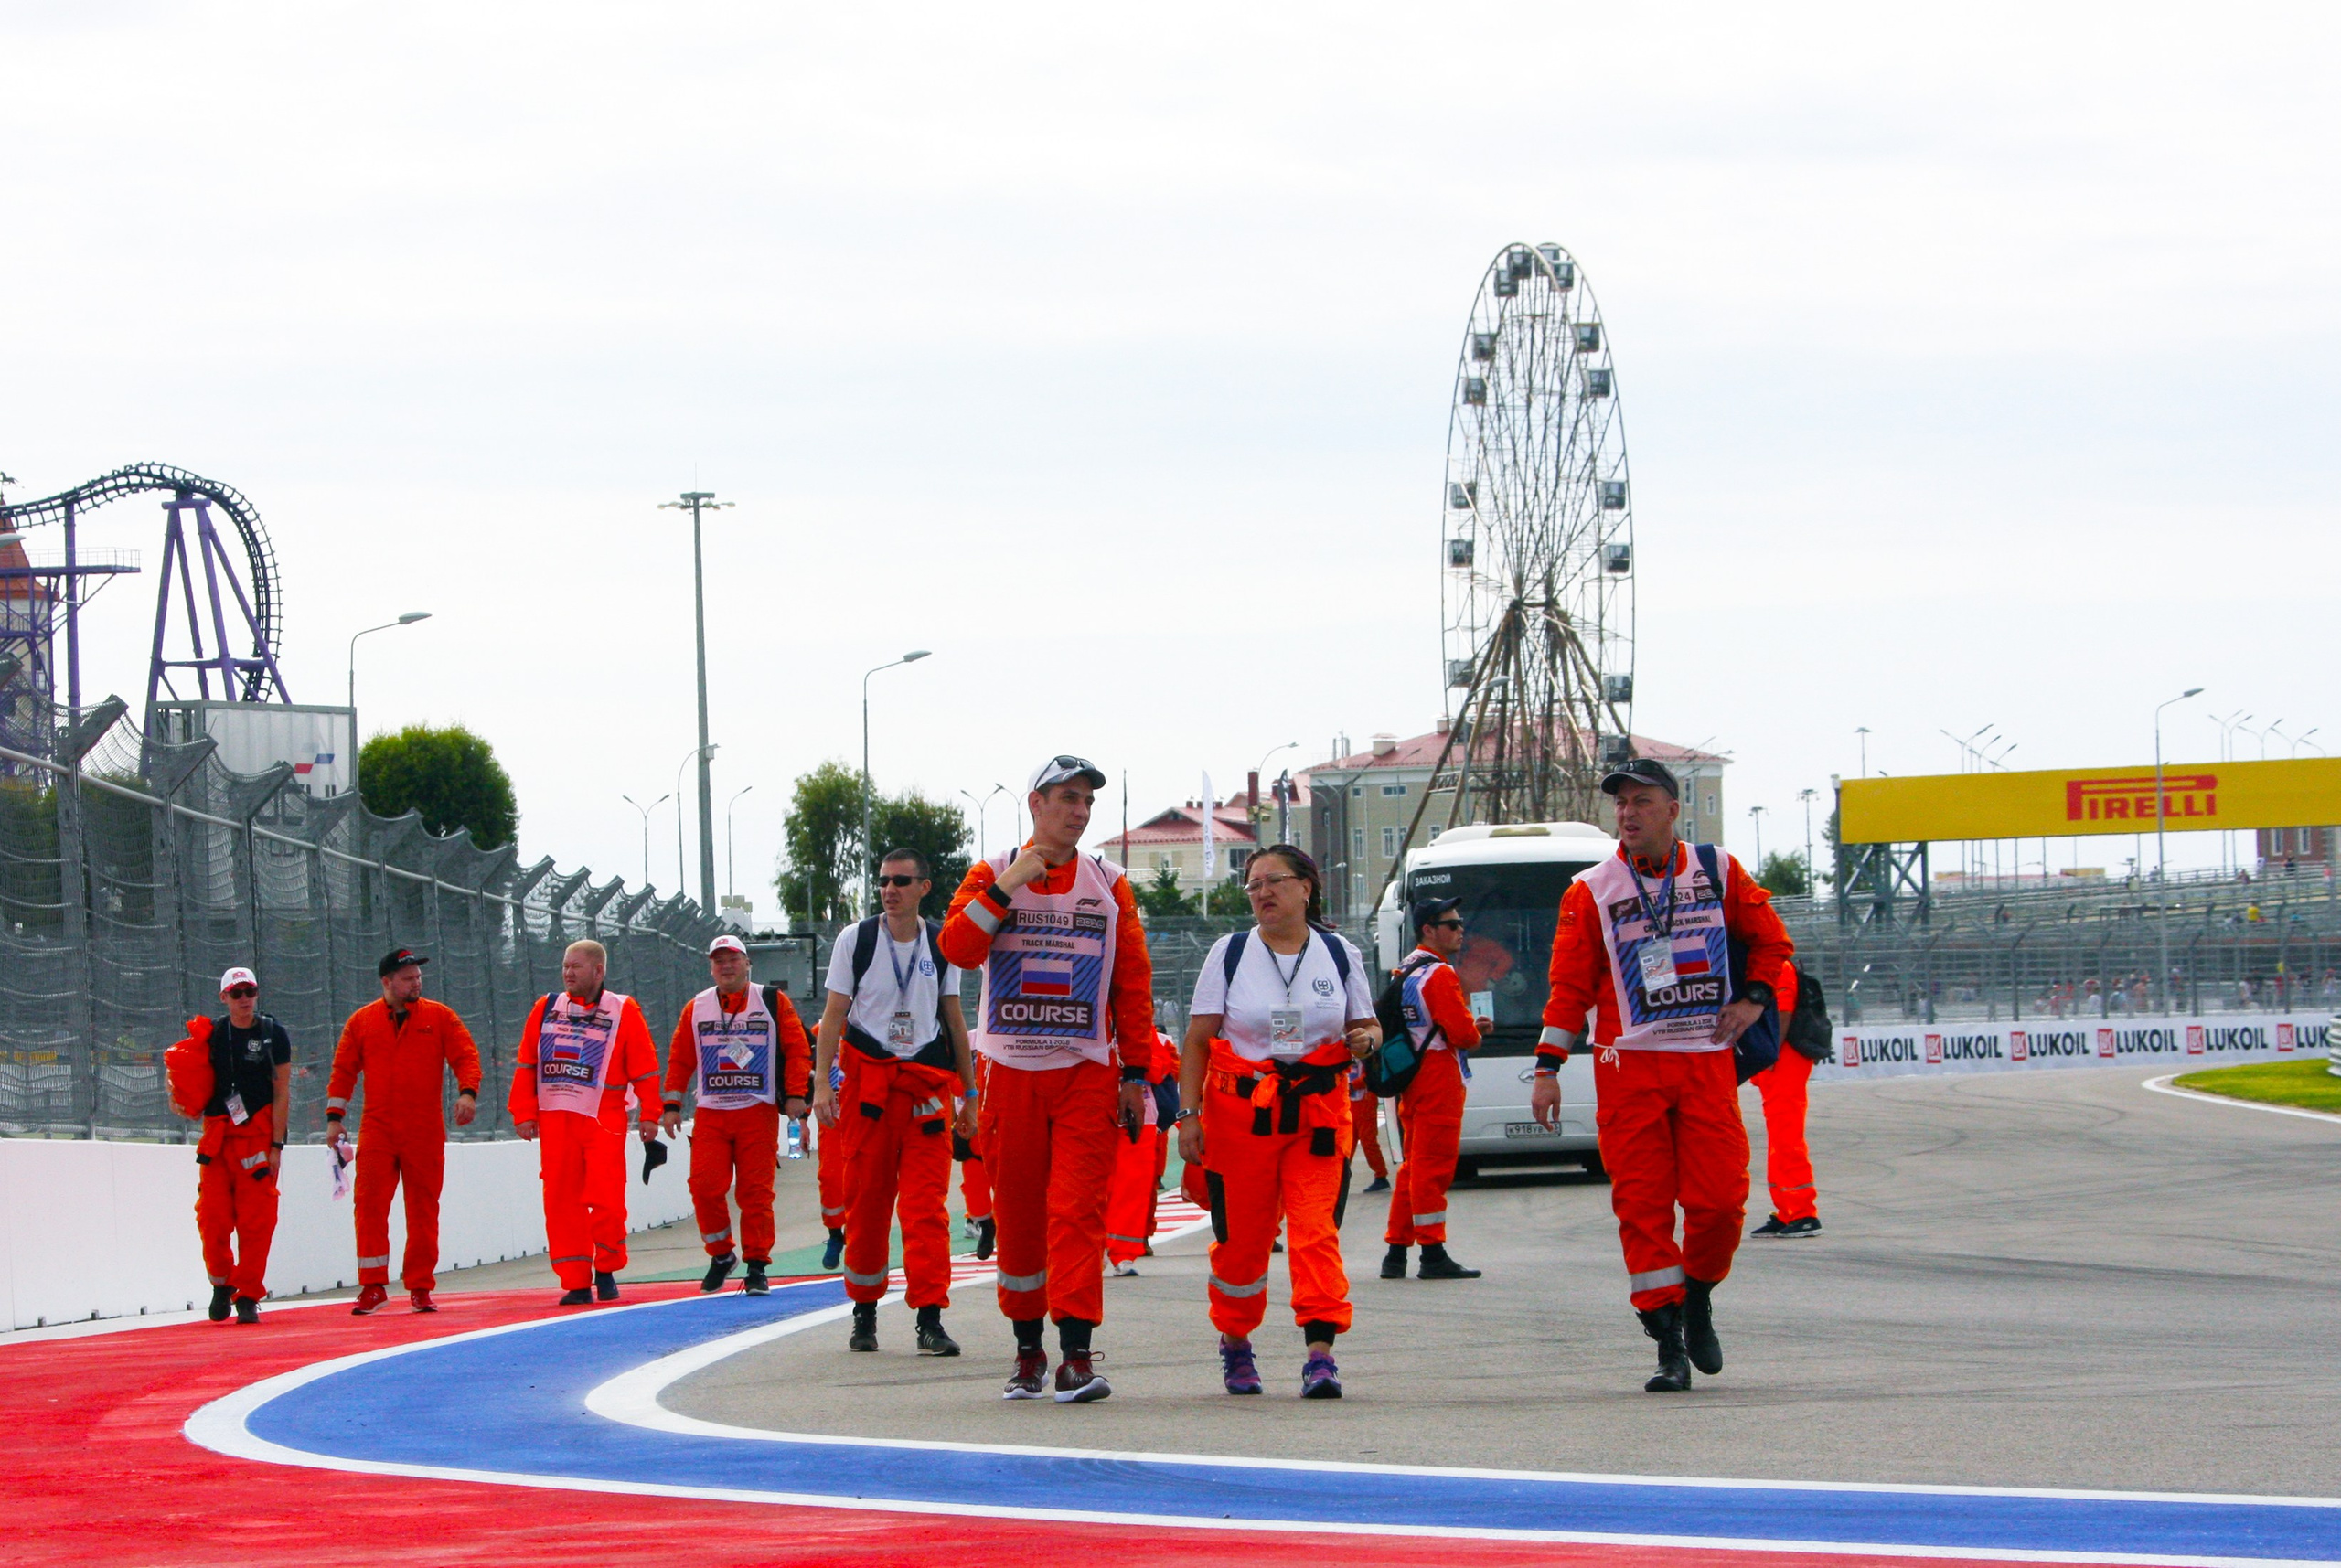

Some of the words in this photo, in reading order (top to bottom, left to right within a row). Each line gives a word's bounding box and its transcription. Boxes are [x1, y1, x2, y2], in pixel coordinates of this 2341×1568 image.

[2067, 774, 2218, 821] PIRELLI
[1415, 872, 1452, 887] ЗАКАЗНОЙ
[1018, 912, 1070, 926] RUS1049
[1075, 917, 1105, 929] 2018
[1021, 938, 1044, 948] TRACK
[1045, 939, 1075, 950] MARSHAL
[1646, 982, 1719, 1008] COURS
[1001, 1003, 1088, 1024] COURSE
[1859, 1037, 1919, 1063] LUKOIL
[1942, 1034, 2003, 1060] LUKOIL
[2027, 1030, 2090, 1057] LUKOIL
[2115, 1029, 2179, 1053] LUKOIL
[2205, 1026, 2269, 1051] LUKOIL
[2295, 1024, 2331, 1049] LUK
[544, 1063, 589, 1078] COURSE
[709, 1075, 759, 1086] COURSE
